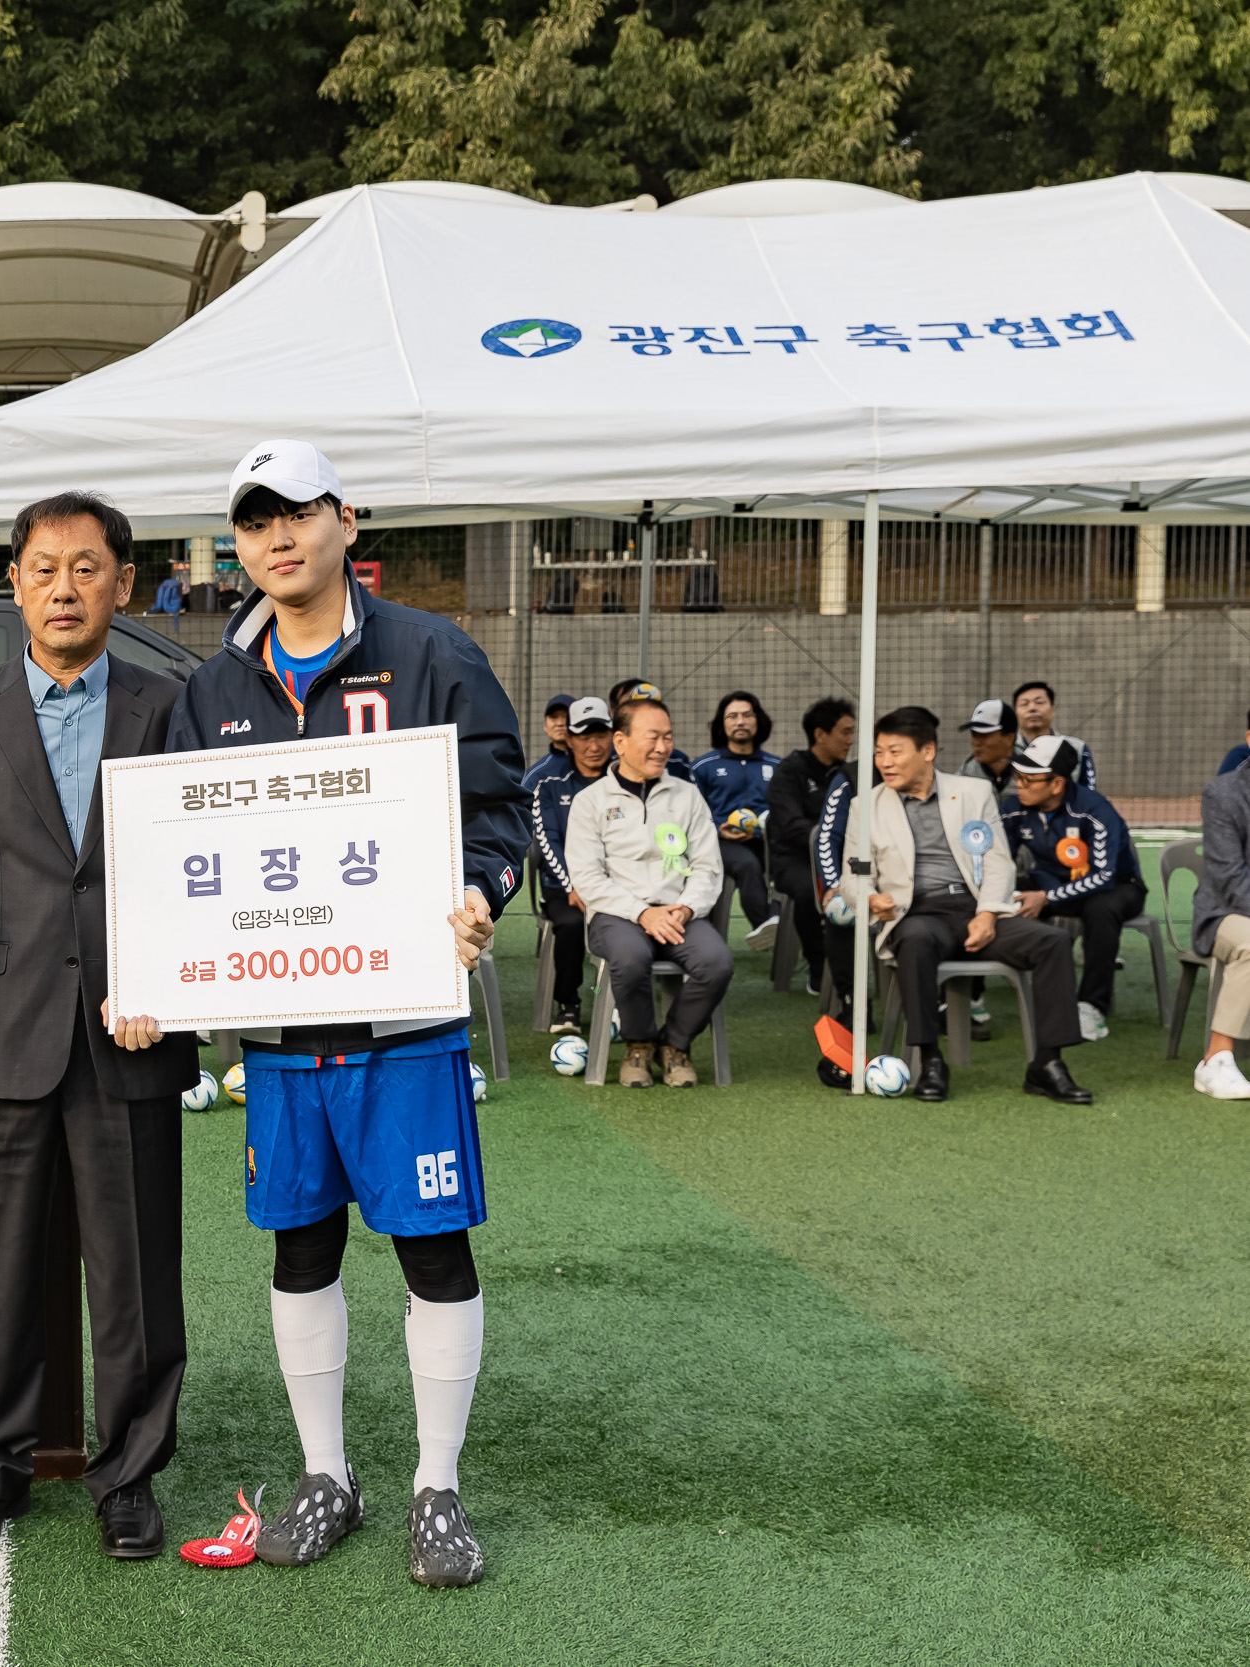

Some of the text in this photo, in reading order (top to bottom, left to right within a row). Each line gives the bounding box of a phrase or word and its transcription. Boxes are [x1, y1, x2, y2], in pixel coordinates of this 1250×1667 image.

[608, 310, 1135, 357] 광진구 축구협회
[254, 452, 274, 464] NIKE
[220, 719, 252, 736] FILA
[181, 767, 371, 811] 광진구 축구협회
[232, 904, 334, 931] (입장식 인원)
[179, 960, 217, 983] 상금
[415, 1149, 459, 1200] 86
